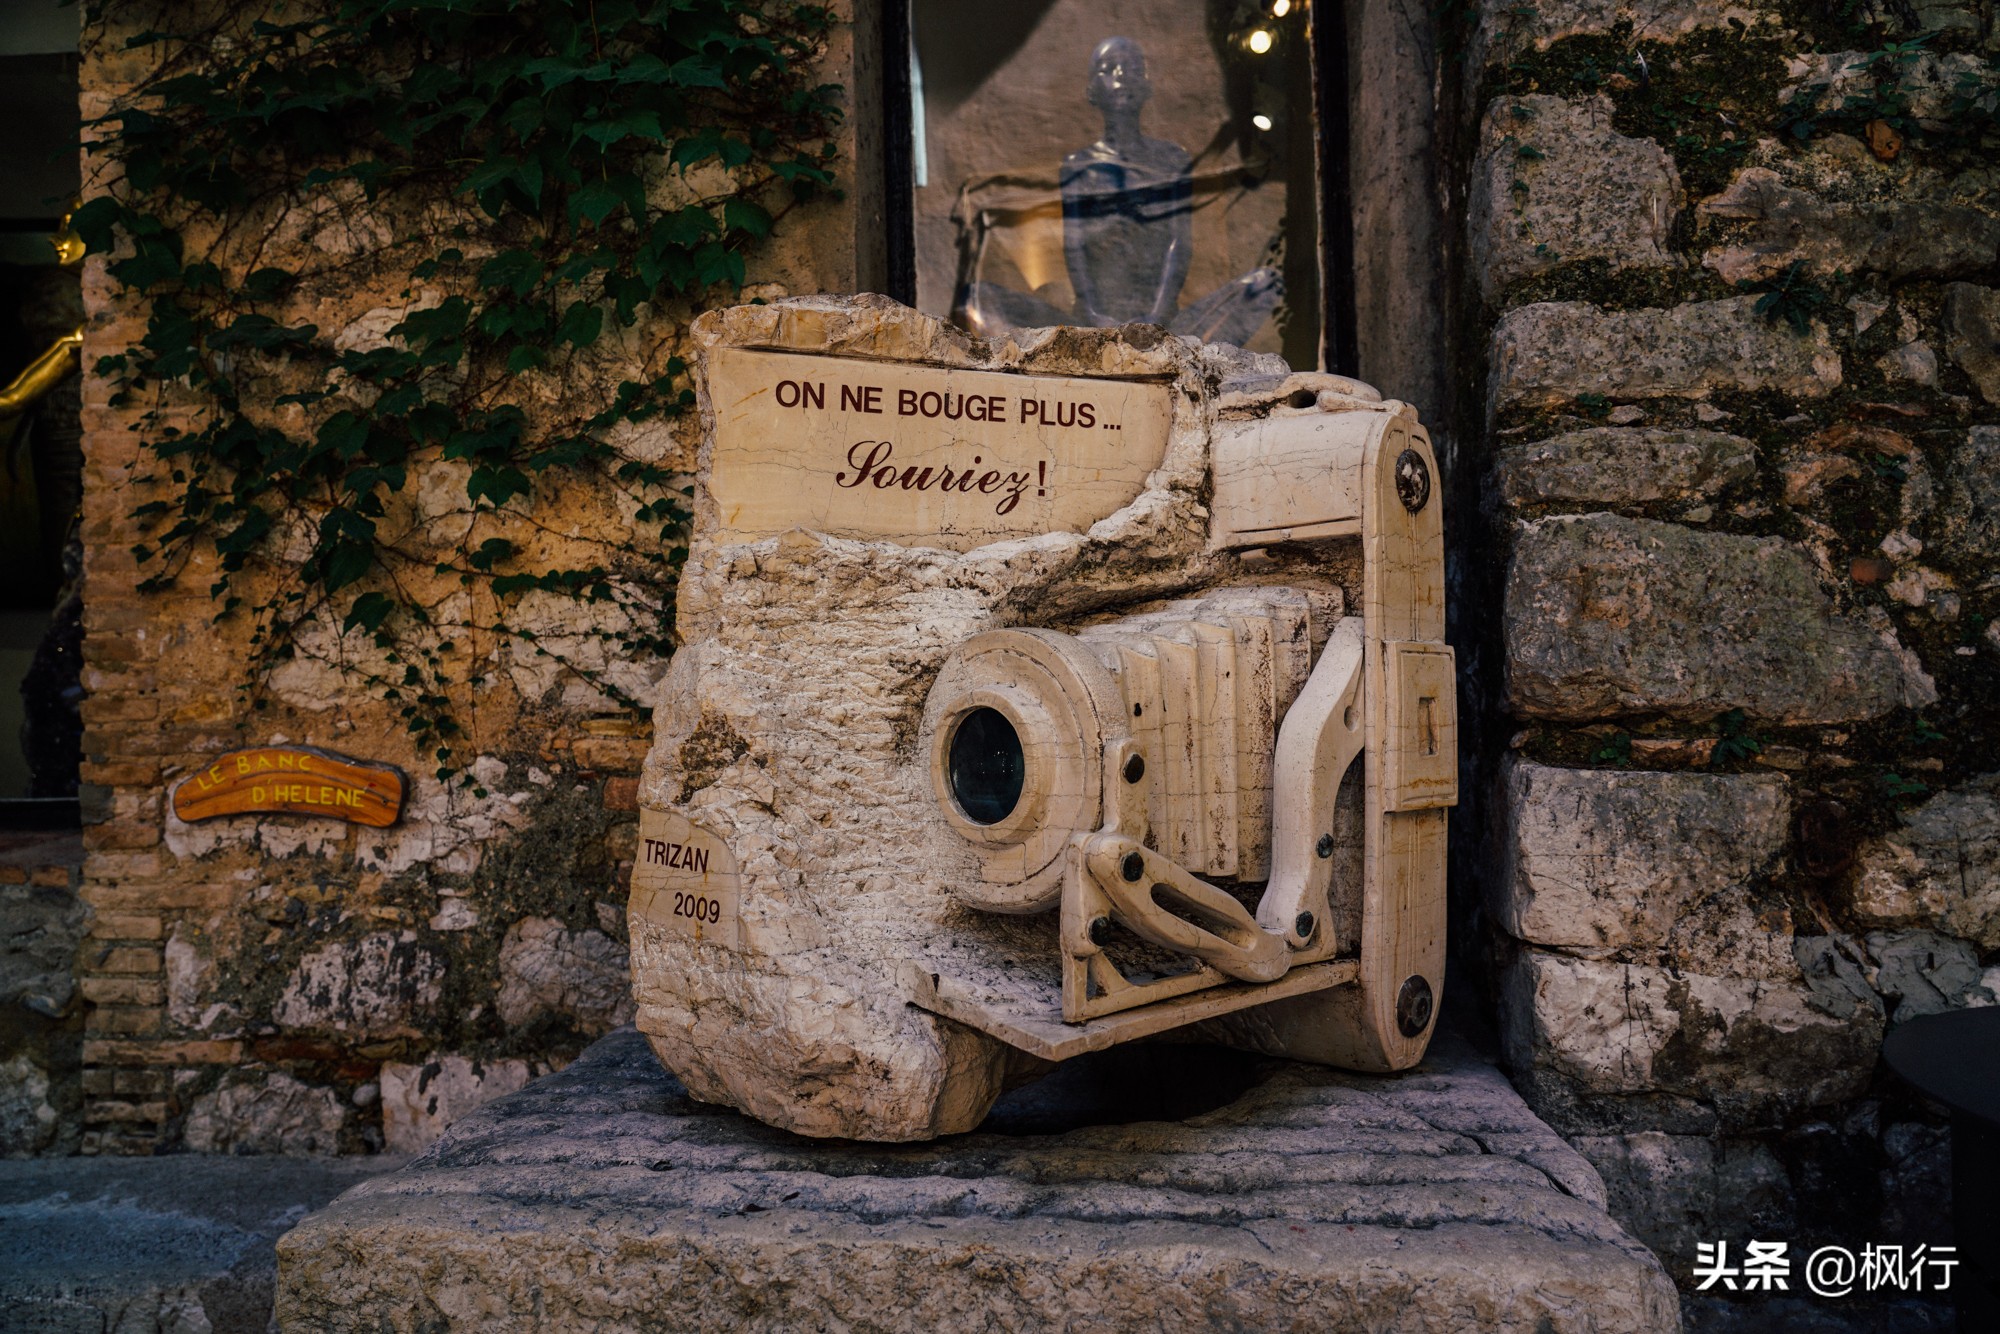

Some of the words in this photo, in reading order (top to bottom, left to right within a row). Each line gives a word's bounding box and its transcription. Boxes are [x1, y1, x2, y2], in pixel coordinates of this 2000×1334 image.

[775, 380, 825, 410] ON
[841, 384, 883, 414] NE
[898, 389, 1006, 423] BOUGE
[836, 440, 1047, 516] Souriez!
[197, 765, 226, 791] LE
[236, 754, 312, 775] BANC
[645, 838, 709, 874] TRIZAN
[673, 891, 720, 924] 2009
